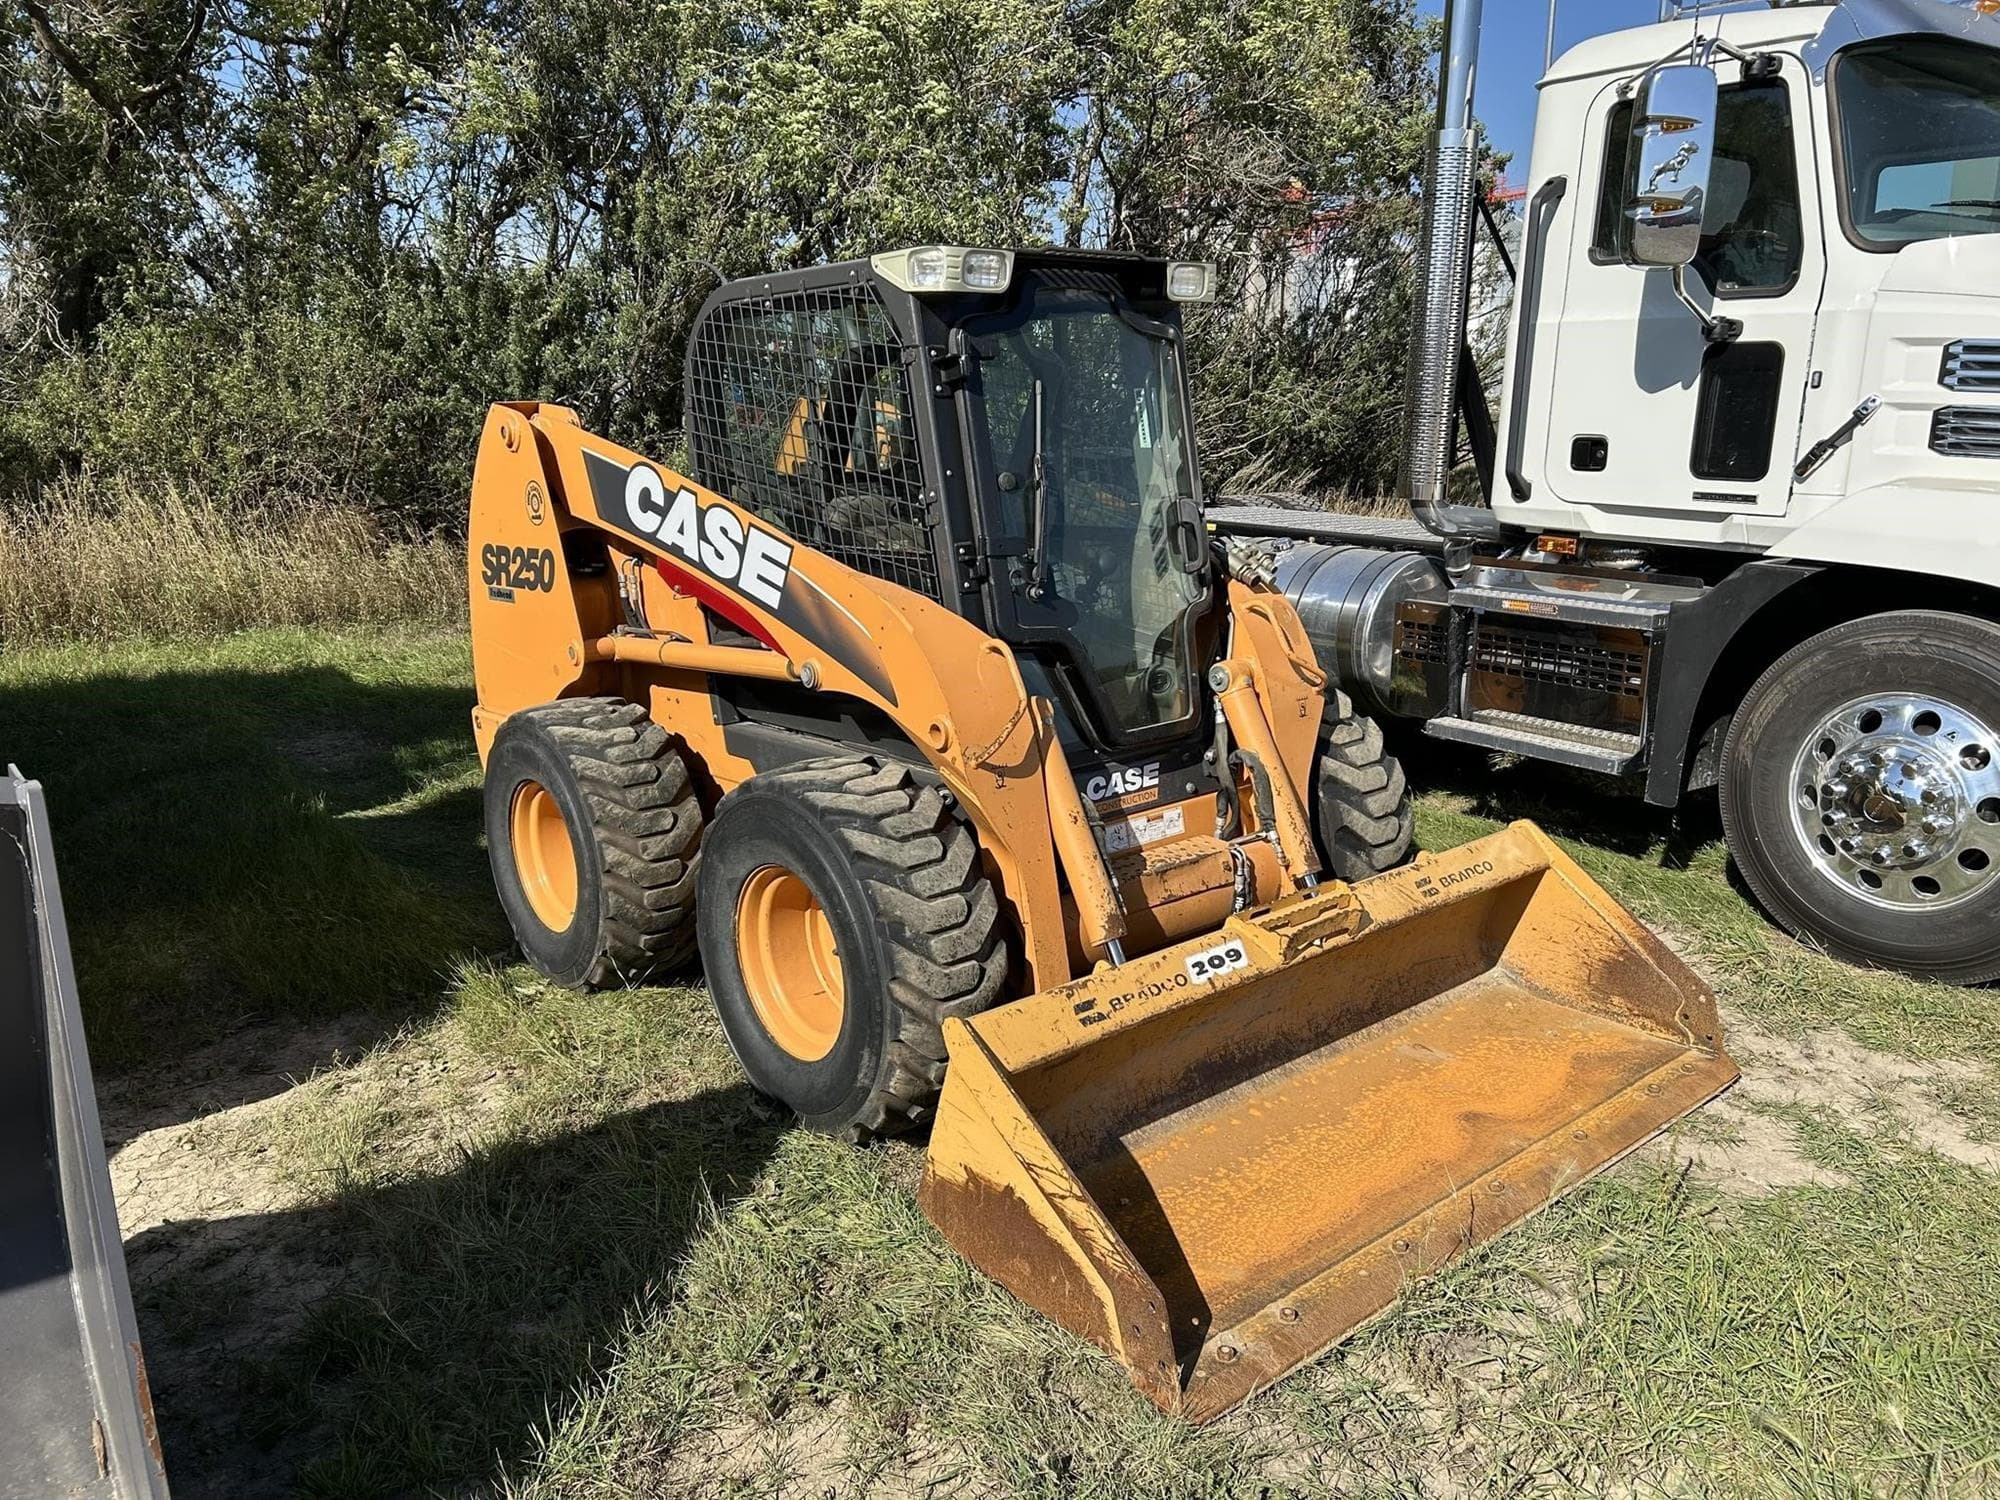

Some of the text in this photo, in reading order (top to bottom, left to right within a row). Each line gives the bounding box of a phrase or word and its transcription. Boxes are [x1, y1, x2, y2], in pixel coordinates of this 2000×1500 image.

[624, 462, 792, 611] CASE
[481, 543, 555, 593] SR250
[1086, 762, 1160, 801] CASE
[1438, 861, 1494, 888] BRADCO
[1191, 948, 1243, 977] 209
